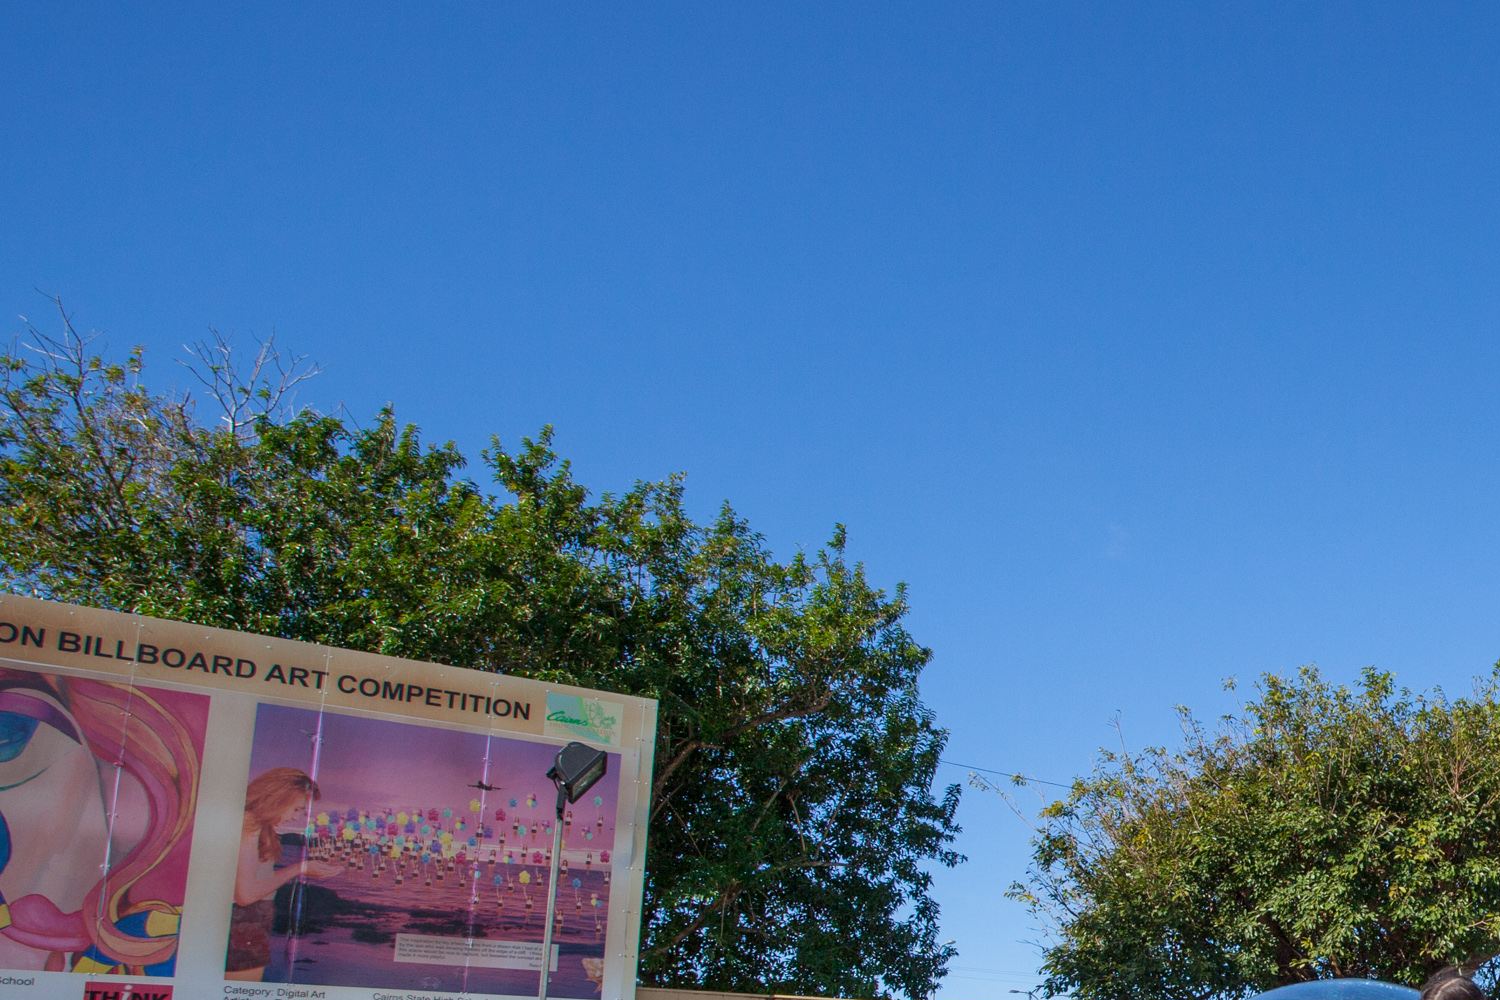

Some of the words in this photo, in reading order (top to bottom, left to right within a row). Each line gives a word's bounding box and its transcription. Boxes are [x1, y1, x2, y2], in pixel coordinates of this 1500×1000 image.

[0, 622, 46, 648] ON
[57, 631, 257, 679] BILLBOARD
[264, 664, 329, 689] ART
[337, 674, 531, 720] COMPETITION
[546, 711, 588, 726] Cairns
[223, 985, 274, 997] Category:
[277, 988, 309, 999] Digital
[311, 990, 326, 998] Art
